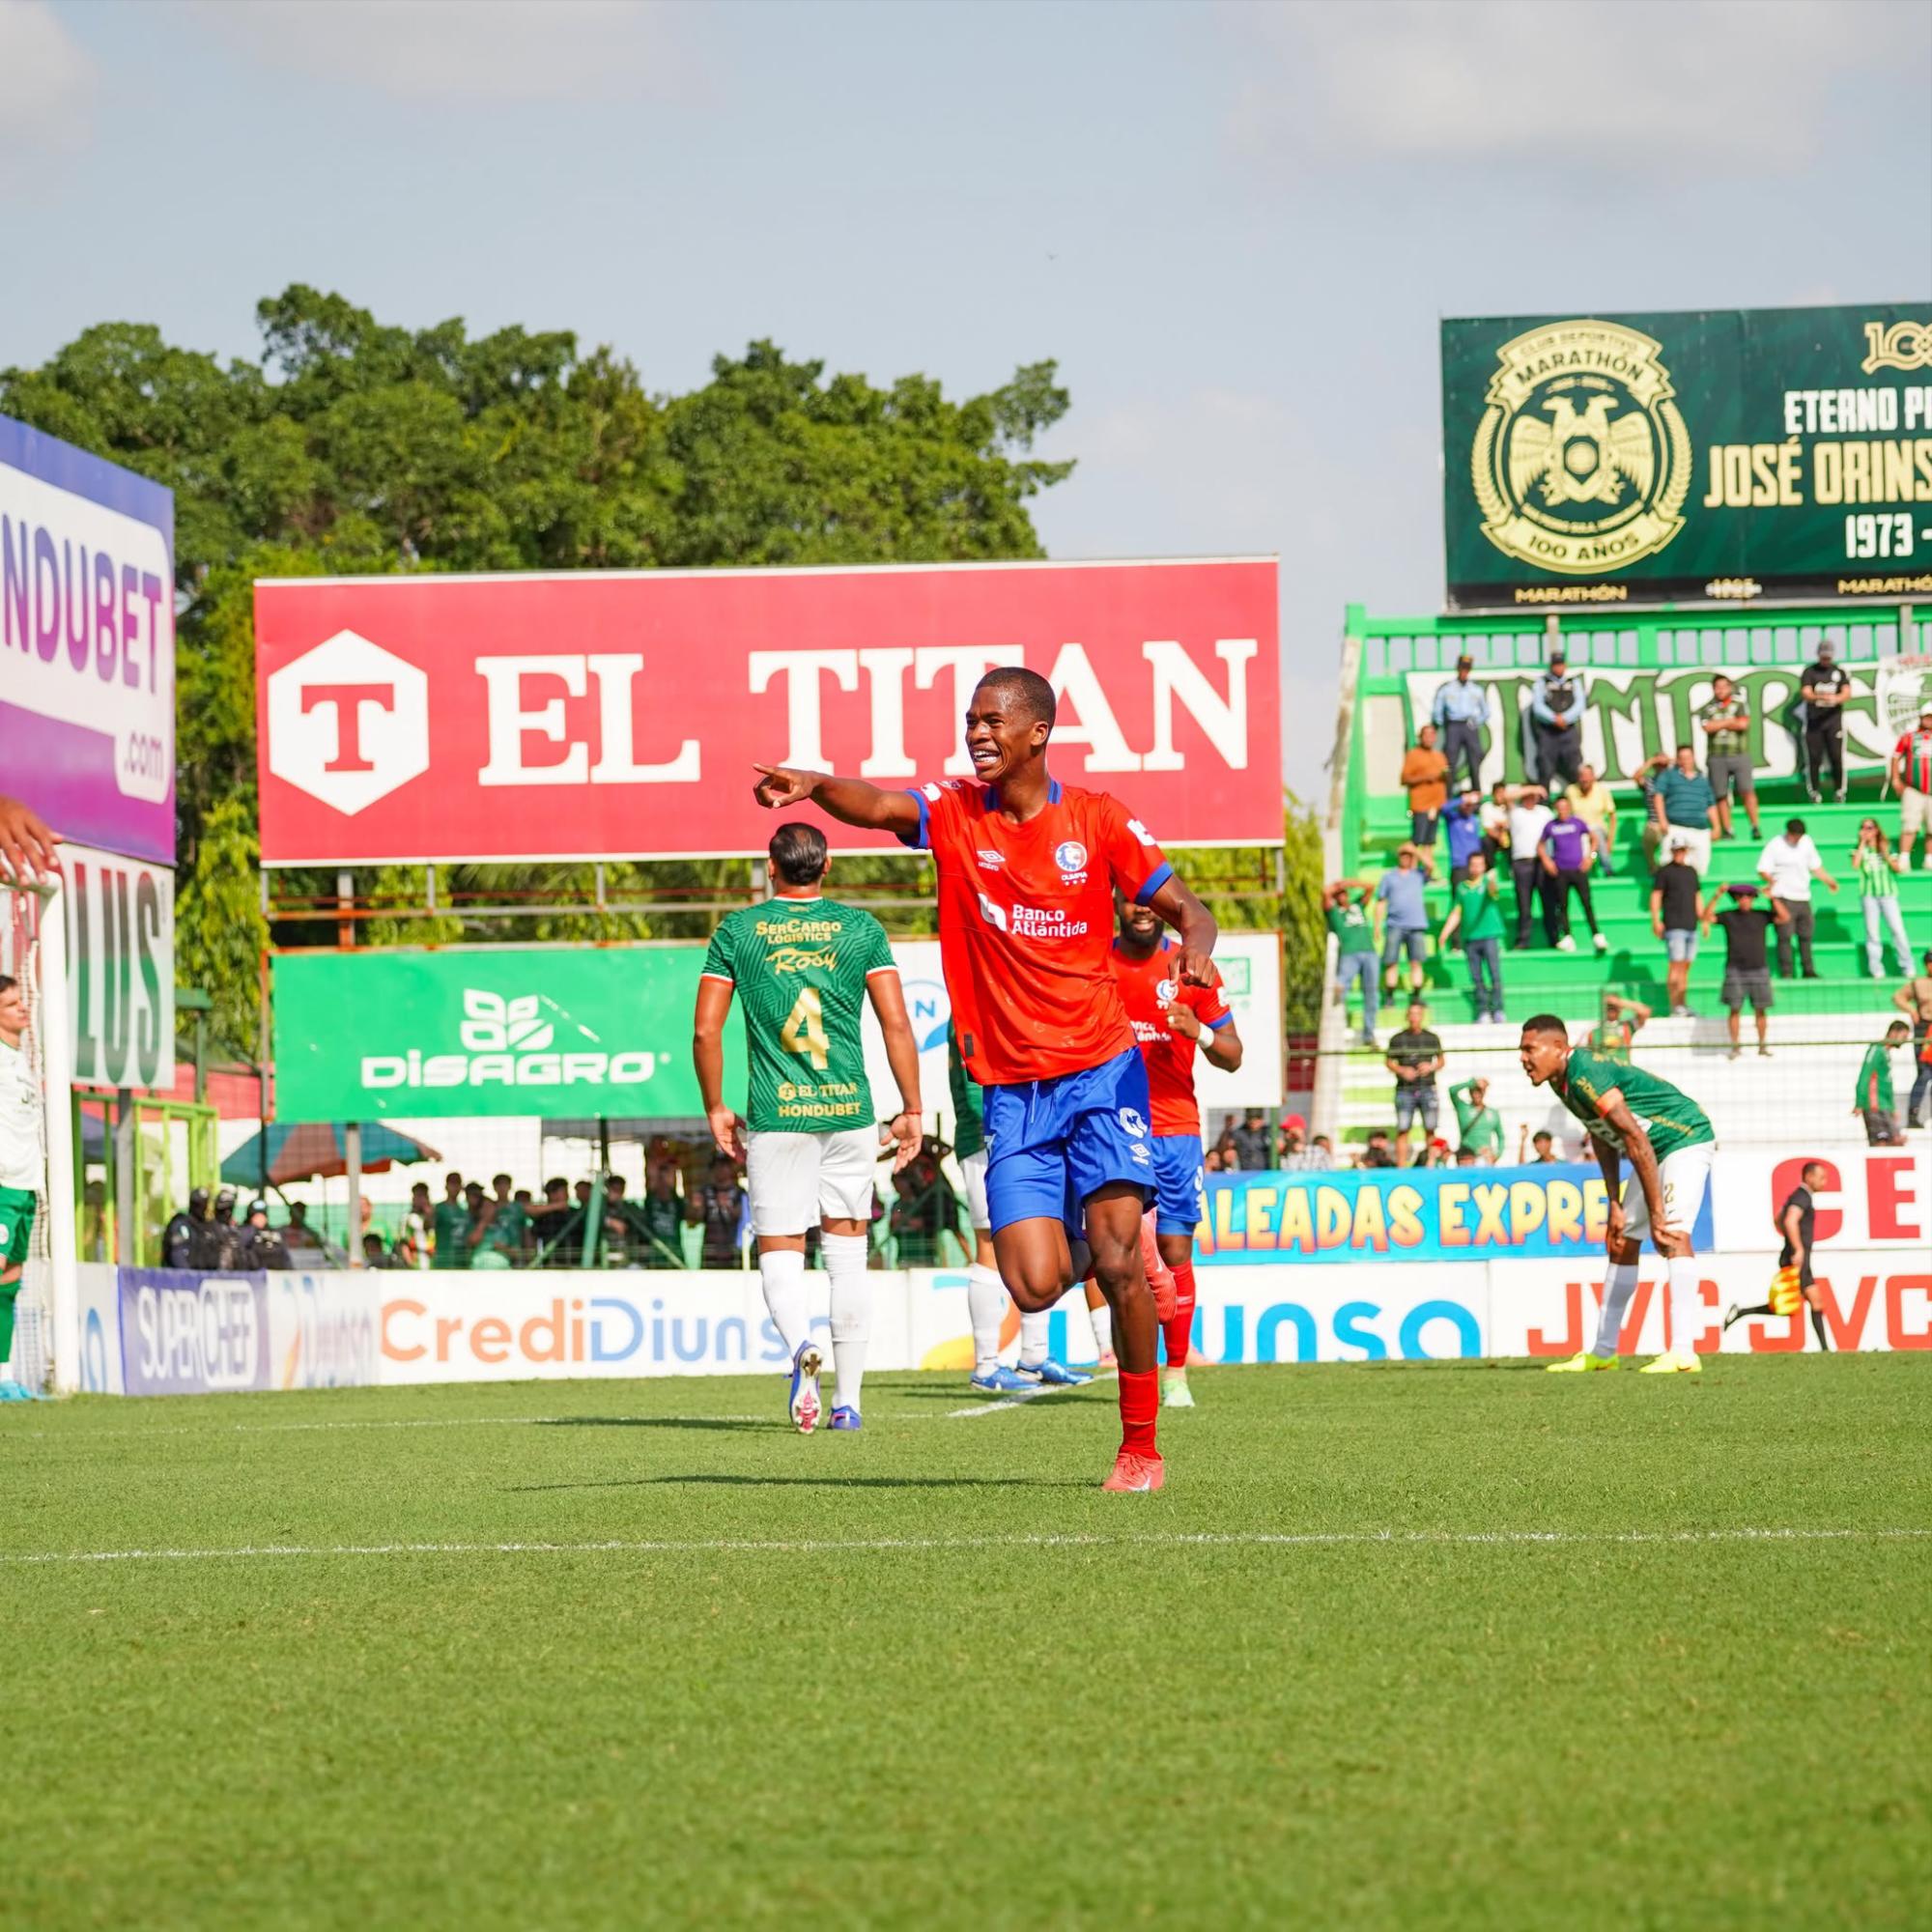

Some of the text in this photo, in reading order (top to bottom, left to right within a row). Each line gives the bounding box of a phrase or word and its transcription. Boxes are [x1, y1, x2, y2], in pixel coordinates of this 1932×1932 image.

[1515, 349, 1646, 385] MARATHÓN
[1784, 387, 1898, 435] ETERNO
[1703, 435, 1932, 508] JOSÉ ORINS
[1528, 531, 1640, 561] 100 AÑOS
[1845, 512, 1915, 559] 1973
[2, 513, 163, 696] NDUBET
[1515, 583, 1628, 604] MARATHÓN
[300, 682, 395, 773] T
[474, 638, 1259, 786] EL TITAN
[124, 731, 163, 780] .com
[1010, 920, 1089, 940] Atlántida
[1012, 903, 1065, 922] Banco
[767, 932, 833, 945] LOGISTICS
[64, 862, 161, 1086] LUS
[780, 986, 831, 1071] 4
[778, 1101, 861, 1118] HONDUBET
[798, 1085, 817, 1097] EL
[1439, 1179, 1629, 1247] EXPRE
[380, 1297, 833, 1364] CrediDiuns
